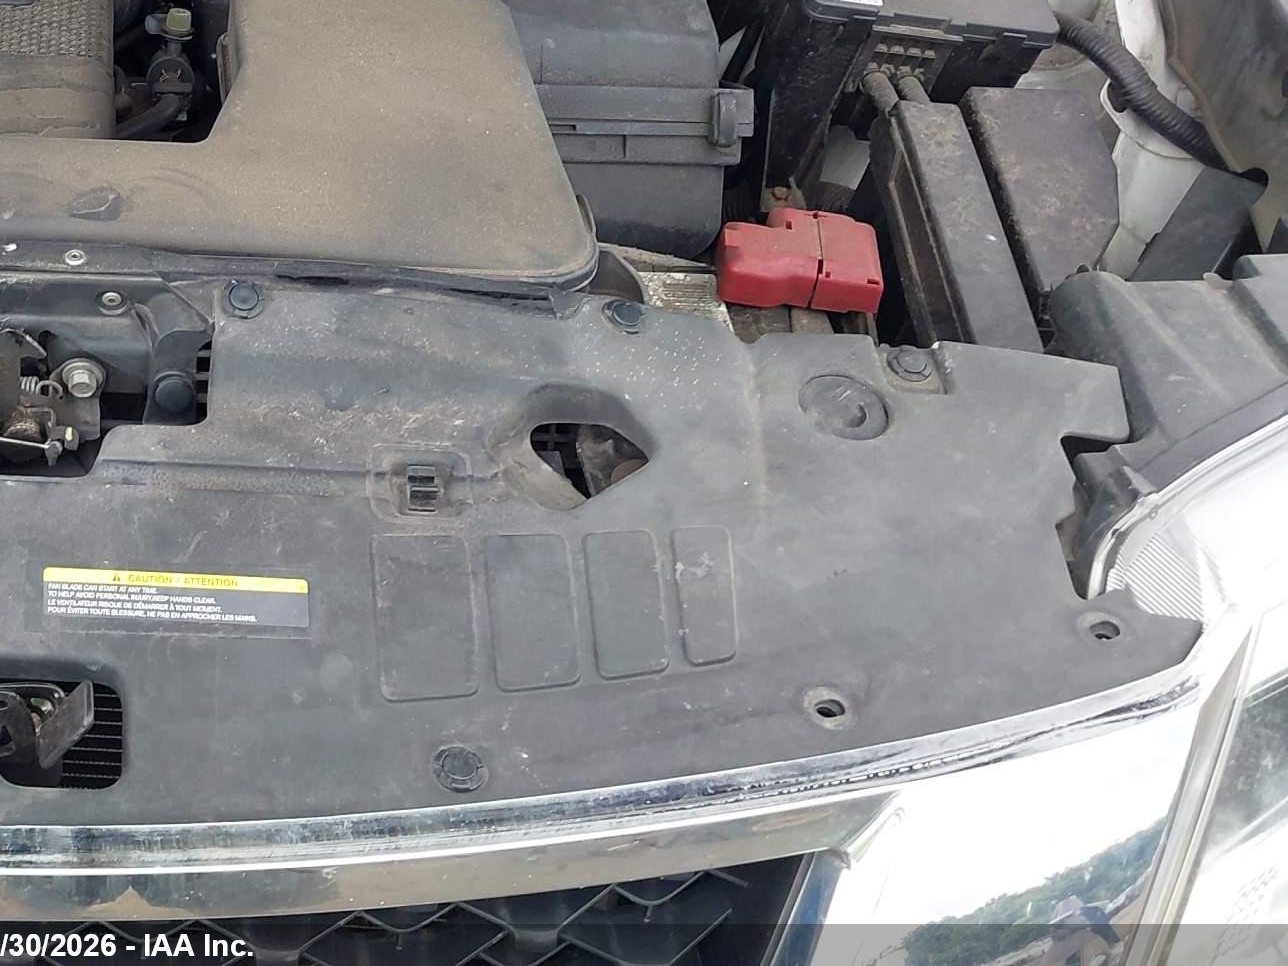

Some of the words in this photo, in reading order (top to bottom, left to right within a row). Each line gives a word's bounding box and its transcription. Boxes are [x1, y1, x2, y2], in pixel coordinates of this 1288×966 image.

[128, 574, 173, 584] CAUTION
[183, 577, 239, 587] ATTENTION
[75, 591, 95, 599] AVOID
[95, 593, 130, 601] PERSONAL
[47, 606, 66, 614] POUR
[67, 605, 89, 614] ÉVITER
[89, 608, 111, 616] TOUTE
[181, 612, 221, 620] APPROCHER
[175, 604, 192, 612] TOUT
